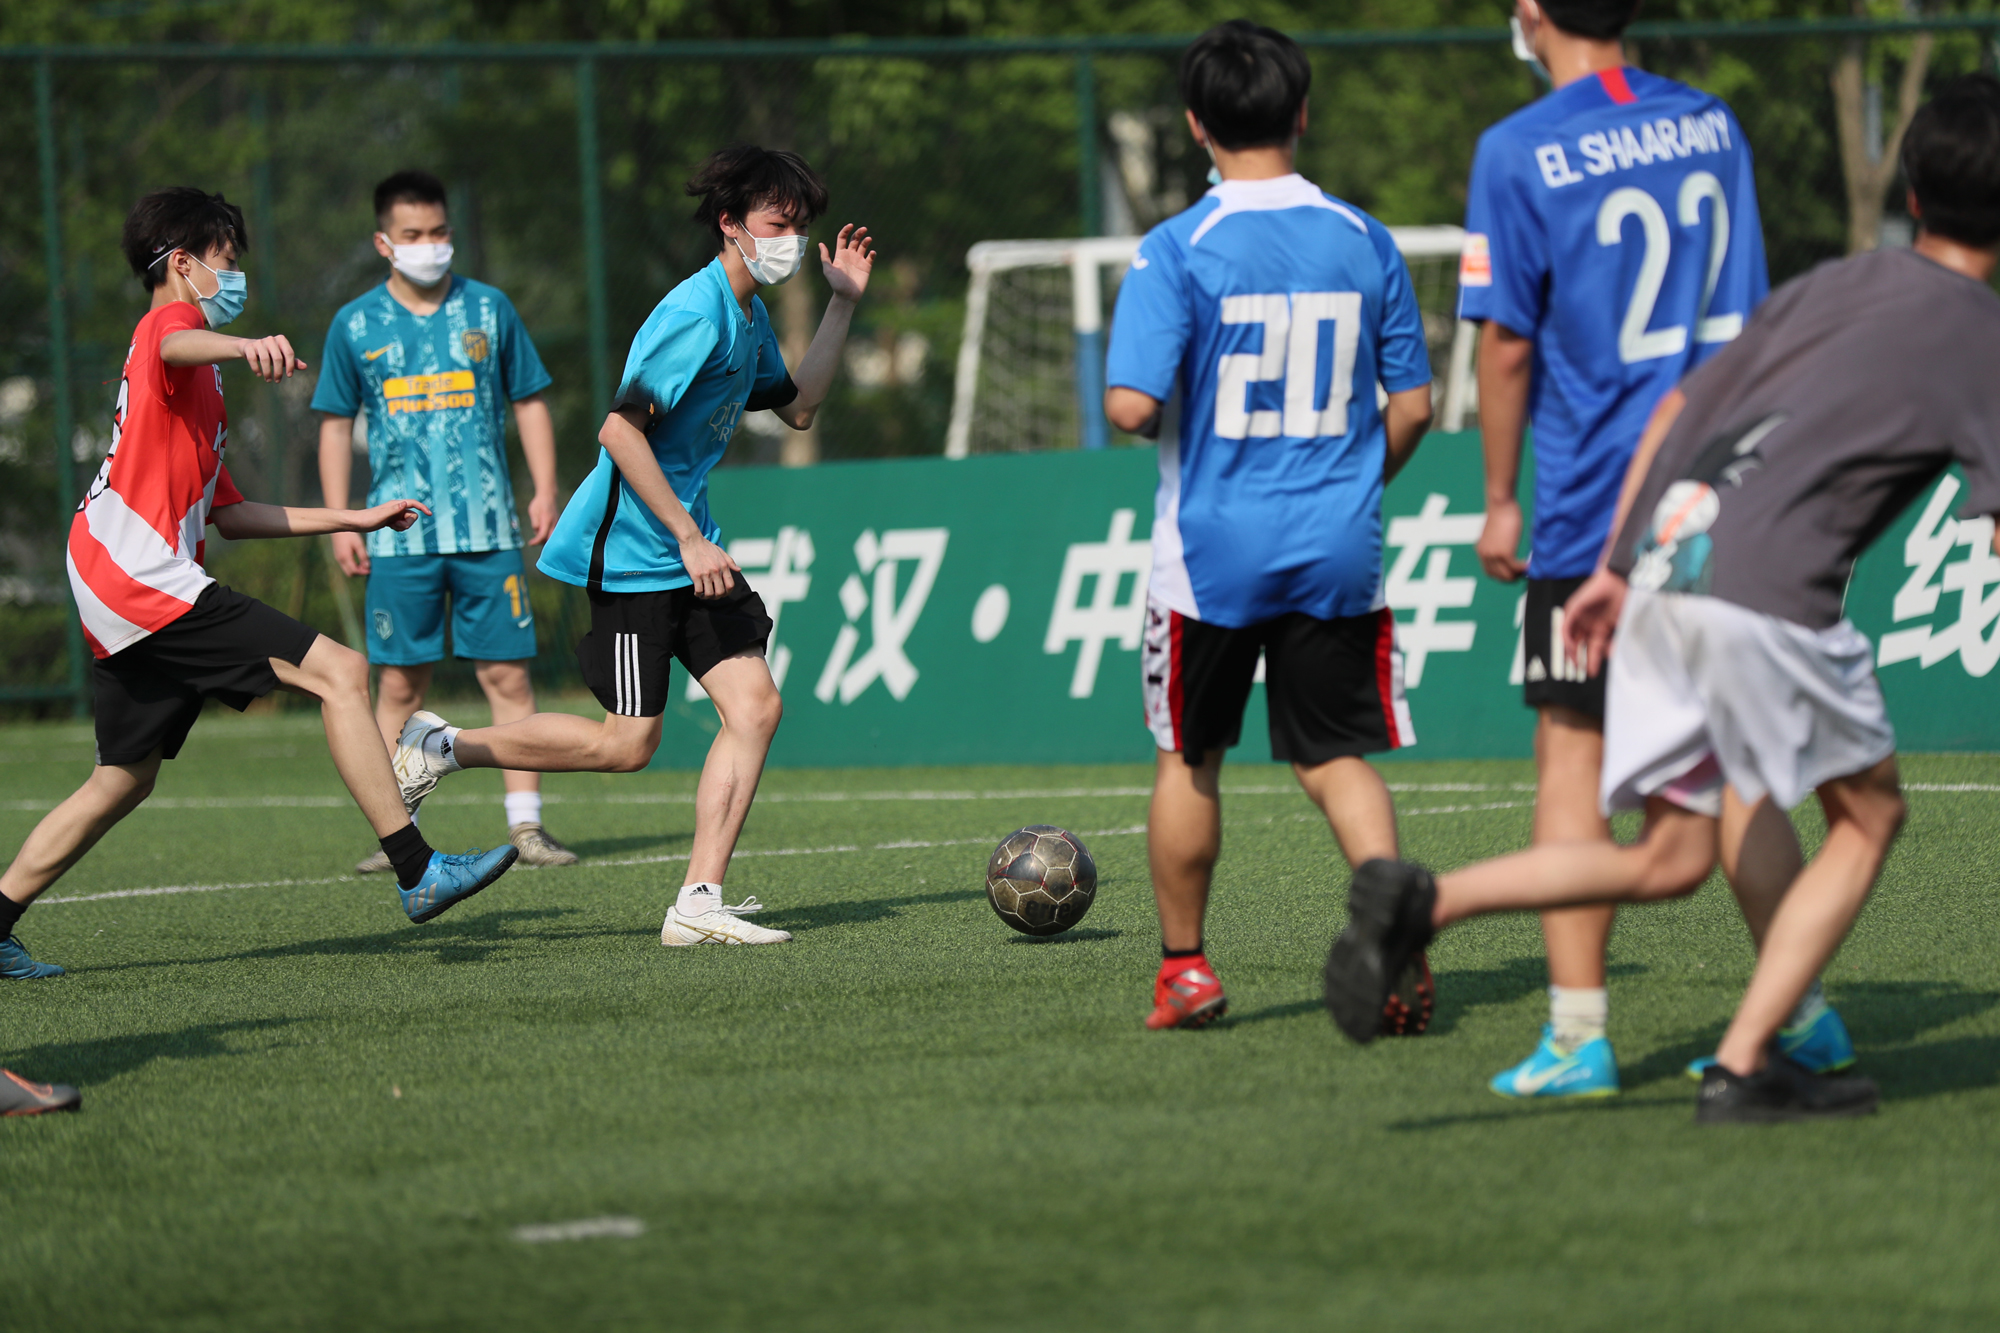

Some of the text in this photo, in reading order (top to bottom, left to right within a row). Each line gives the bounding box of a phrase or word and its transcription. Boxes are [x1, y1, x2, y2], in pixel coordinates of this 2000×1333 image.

[1535, 109, 1732, 189] EL SHAARAWY
[1596, 170, 1744, 365] 22
[387, 391, 475, 416] Plus500
[405, 375, 454, 393] Trade
[1214, 291, 1362, 440] 20
